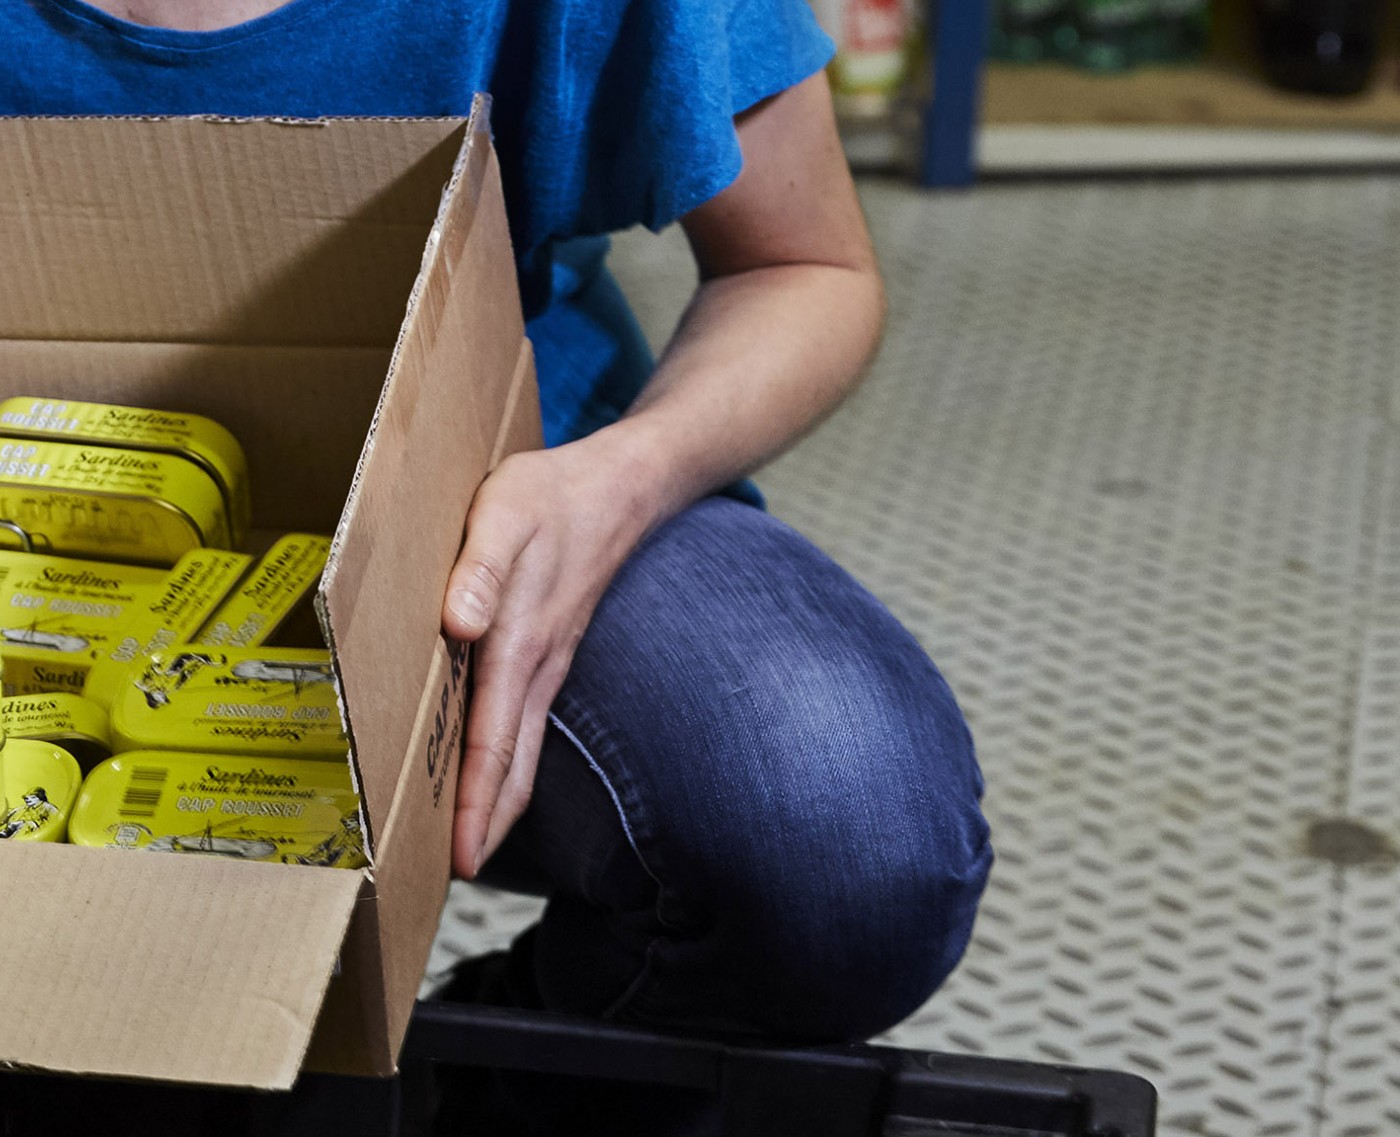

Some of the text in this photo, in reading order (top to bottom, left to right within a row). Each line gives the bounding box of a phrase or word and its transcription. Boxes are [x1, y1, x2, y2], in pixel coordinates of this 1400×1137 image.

[106, 408, 188, 428] Sardines
[0, 443, 38, 459] CAP
[75, 450, 161, 470] Sardines
[38, 566, 121, 590] Sardines
[242, 543, 300, 598] Sardines
[149, 560, 204, 612] Sardines
[10, 592, 45, 608] CAP
[33, 666, 86, 687] Sardi
[1, 700, 58, 715] dines
[204, 702, 331, 720] CAP ROUSSET
[210, 725, 306, 743] Sardines
[427, 682, 449, 778] CAP
[202, 765, 298, 788] Sardines
[177, 796, 305, 817] CAP ROUSSET
